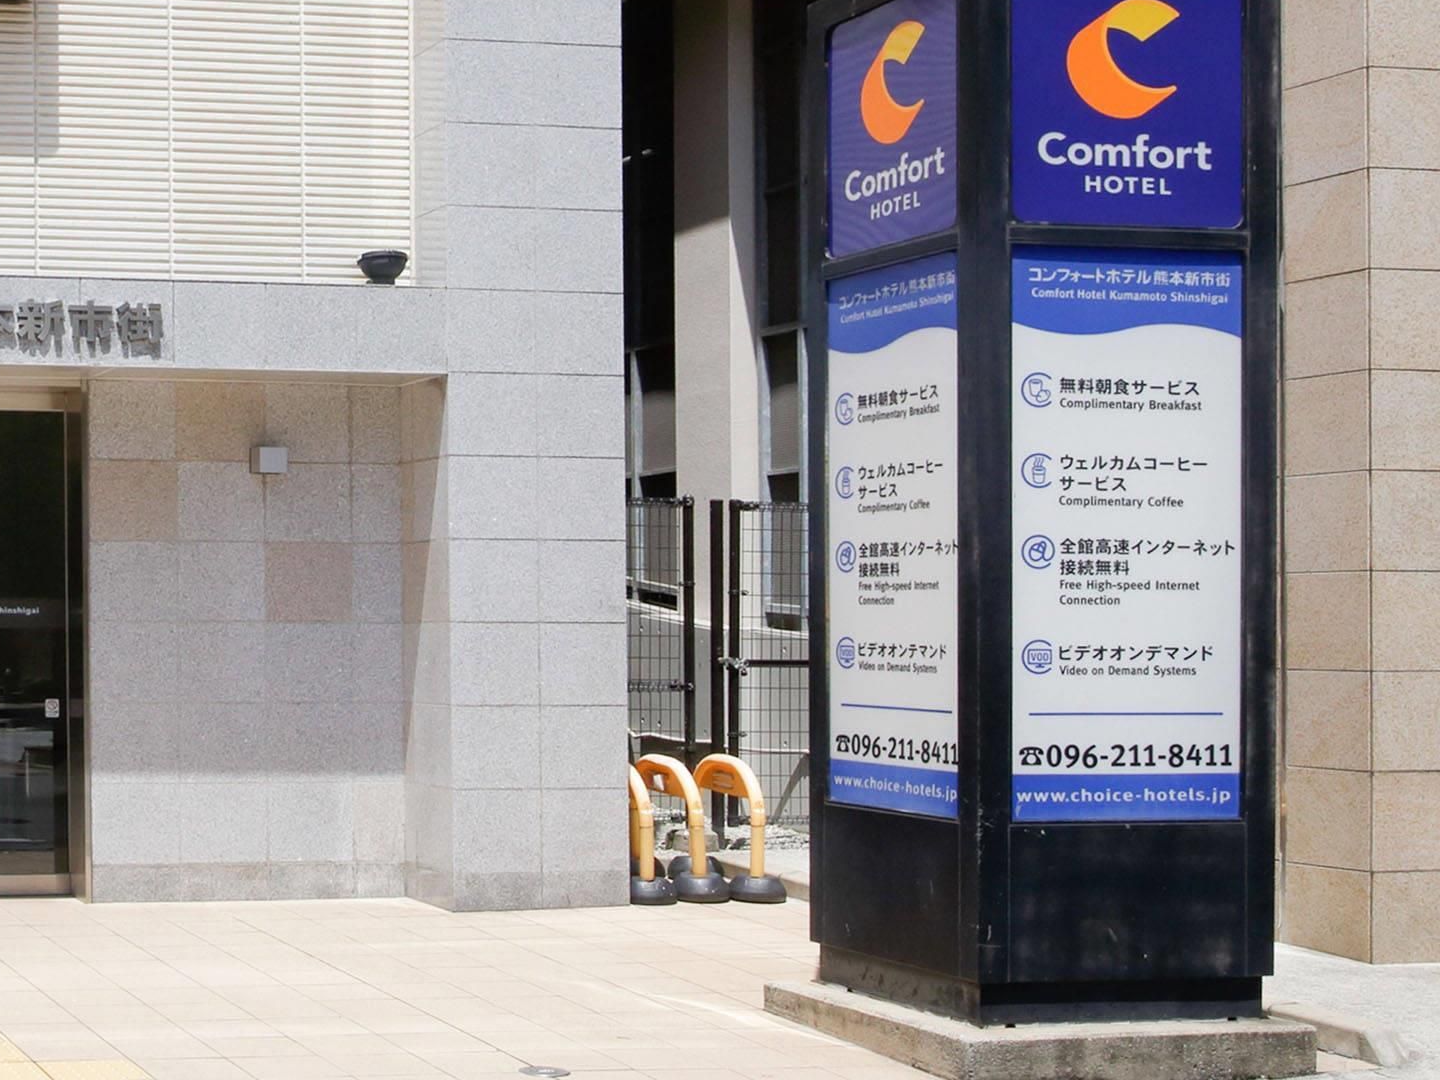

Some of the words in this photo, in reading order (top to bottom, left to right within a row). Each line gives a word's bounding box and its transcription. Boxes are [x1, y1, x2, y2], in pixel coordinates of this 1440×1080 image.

[1037, 131, 1213, 171] Comfort
[844, 146, 946, 202] Comfort
[1084, 175, 1172, 196] HOTEL
[870, 191, 921, 220] HOTEL
[1027, 267, 1231, 288] コンフォートホテル熊本新市街
[1031, 287, 1074, 300] Comfort
[1077, 289, 1106, 301] Hotel
[1109, 290, 1167, 302] Kumamoto
[1170, 291, 1228, 305] Shinshigai
[1059, 377, 1200, 396] 無料朝食サービス
[857, 384, 939, 410] 無料朝食サービス
[1059, 398, 1145, 412] Complimentary
[1149, 399, 1202, 411] Breakfast
[857, 409, 907, 424] Complimentary
[909, 403, 941, 417] Breakfast
[858, 459, 944, 481] ウェルカムコーヒー
[1060, 454, 1208, 472] ウェルカムコーヒー
[858, 483, 898, 500] サービス
[1059, 475, 1127, 492] サービス
[857, 501, 908, 515] Complimentary
[909, 499, 930, 511] Coffee
[1058, 495, 1144, 509] Complimentary
[1147, 496, 1184, 508] Coffee
[1060, 538, 1236, 556] 全館高速インターネット
[858, 562, 900, 578] 接続無料
[1059, 560, 1130, 576] 接続無料
[858, 581, 872, 591] Free
[874, 581, 911, 593] High-speed
[914, 580, 939, 590] Internet
[1059, 580, 1082, 590] Free
[1086, 580, 1150, 592] High-speed
[1155, 580, 1200, 591] Internet
[858, 595, 895, 606] Connection
[1059, 594, 1121, 606] Connection
[1030, 652, 1049, 662] VOD
[1058, 645, 1213, 662] ビデオオンデマンド
[858, 661, 875, 671] Video
[887, 662, 910, 673] Demand
[912, 663, 938, 675] Systems
[1059, 665, 1088, 676] Video
[1091, 668, 1104, 676] on
[1108, 665, 1150, 676] Demand
[1153, 666, 1197, 678] Systems
[1046, 743, 1232, 769] 096-211-8411
[833, 773, 958, 803] www.choice-hotels.jp
[1016, 787, 1232, 805] www.choice-hotels.jp
